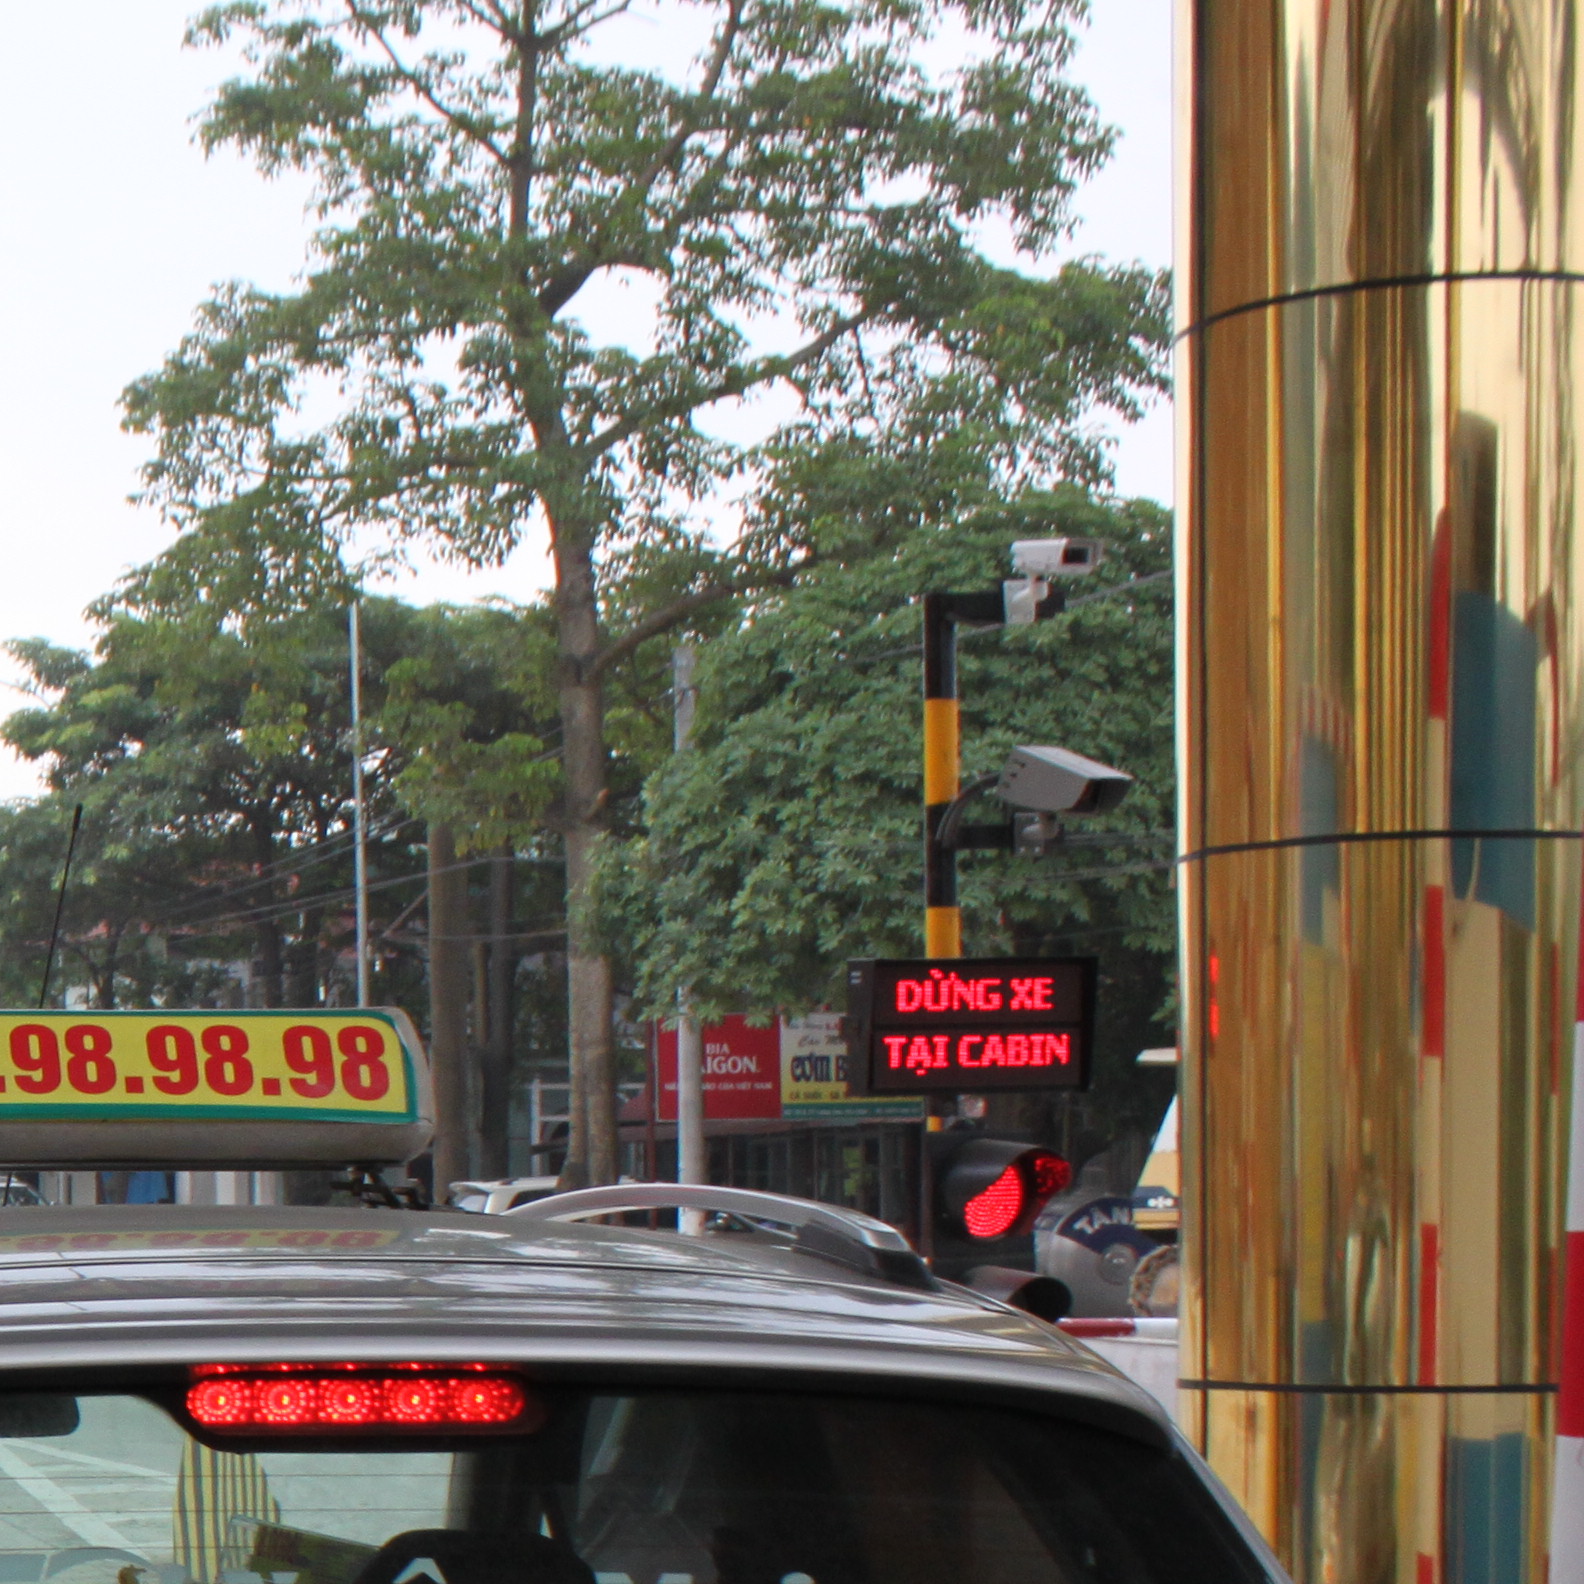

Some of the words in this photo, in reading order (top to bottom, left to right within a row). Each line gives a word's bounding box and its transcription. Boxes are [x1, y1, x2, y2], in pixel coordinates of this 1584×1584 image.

[895, 968, 1003, 1012] DỪNG
[1010, 977, 1054, 1011] XE
[705, 1042, 731, 1054] BIA
[883, 1034, 951, 1076] TẠI
[957, 1032, 1071, 1068] CABIN
[701, 1055, 758, 1075] IGON
